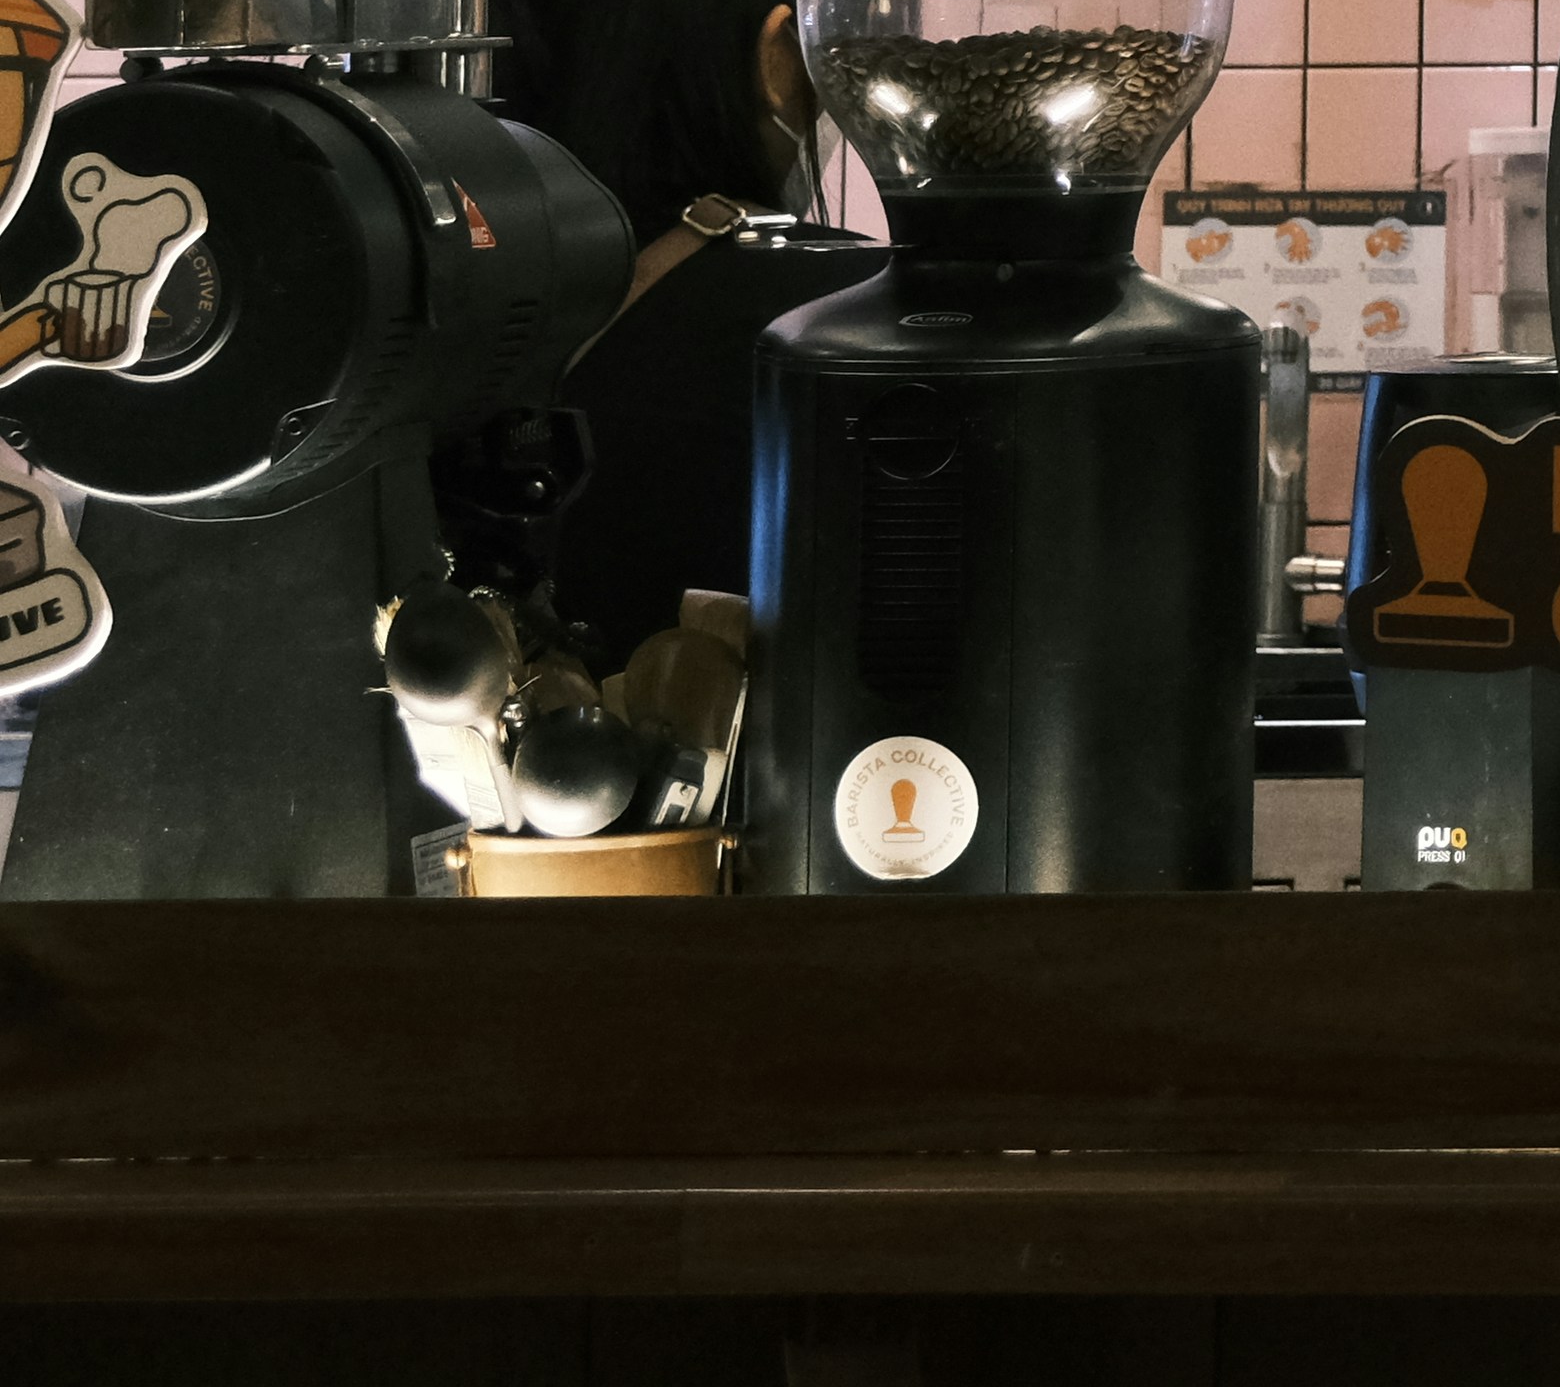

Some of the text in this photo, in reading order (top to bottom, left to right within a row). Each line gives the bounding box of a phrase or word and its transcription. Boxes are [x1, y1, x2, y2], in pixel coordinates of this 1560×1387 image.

[184, 245, 215, 313] ECTIVE
[847, 749, 965, 828] BARISTA COLLECTIVE
[1417, 850, 1452, 863] PRESS
